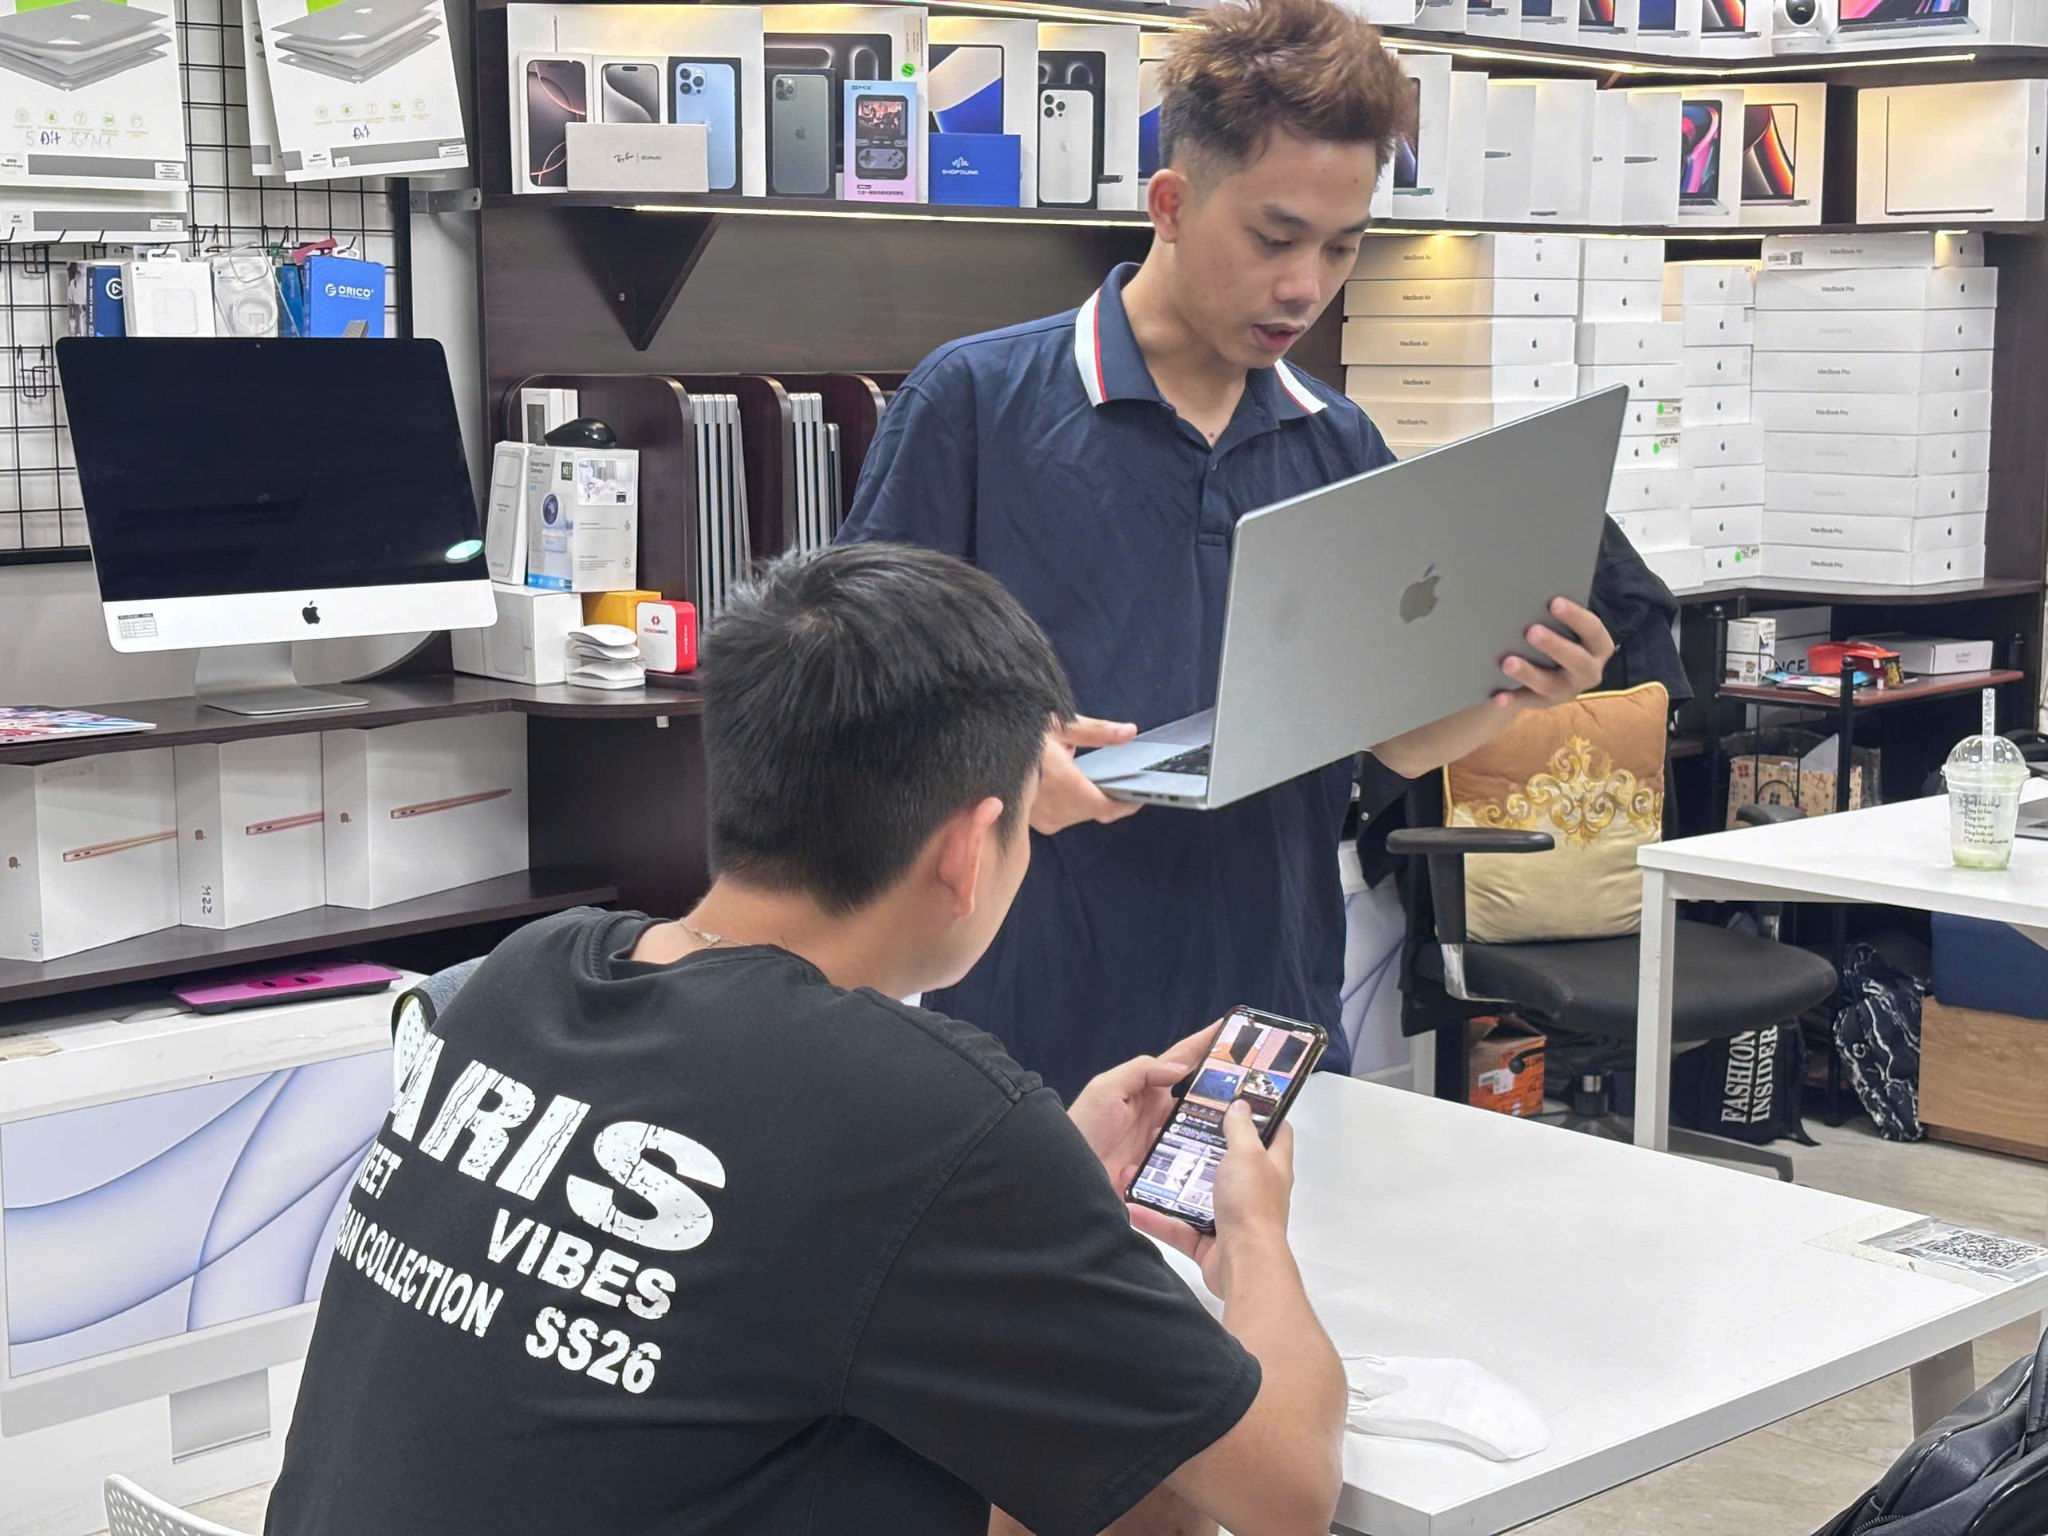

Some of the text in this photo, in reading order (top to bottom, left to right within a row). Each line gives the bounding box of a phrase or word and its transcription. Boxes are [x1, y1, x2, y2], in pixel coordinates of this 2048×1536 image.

[338, 285, 371, 298] ORICO
[1720, 1030, 1756, 1124] FASHION
[1751, 1024, 1778, 1124] INSIDER
[355, 1223, 504, 1338] COLLECTION
[525, 1306, 662, 1394] SS26
[487, 1208, 677, 1320] VIBES
